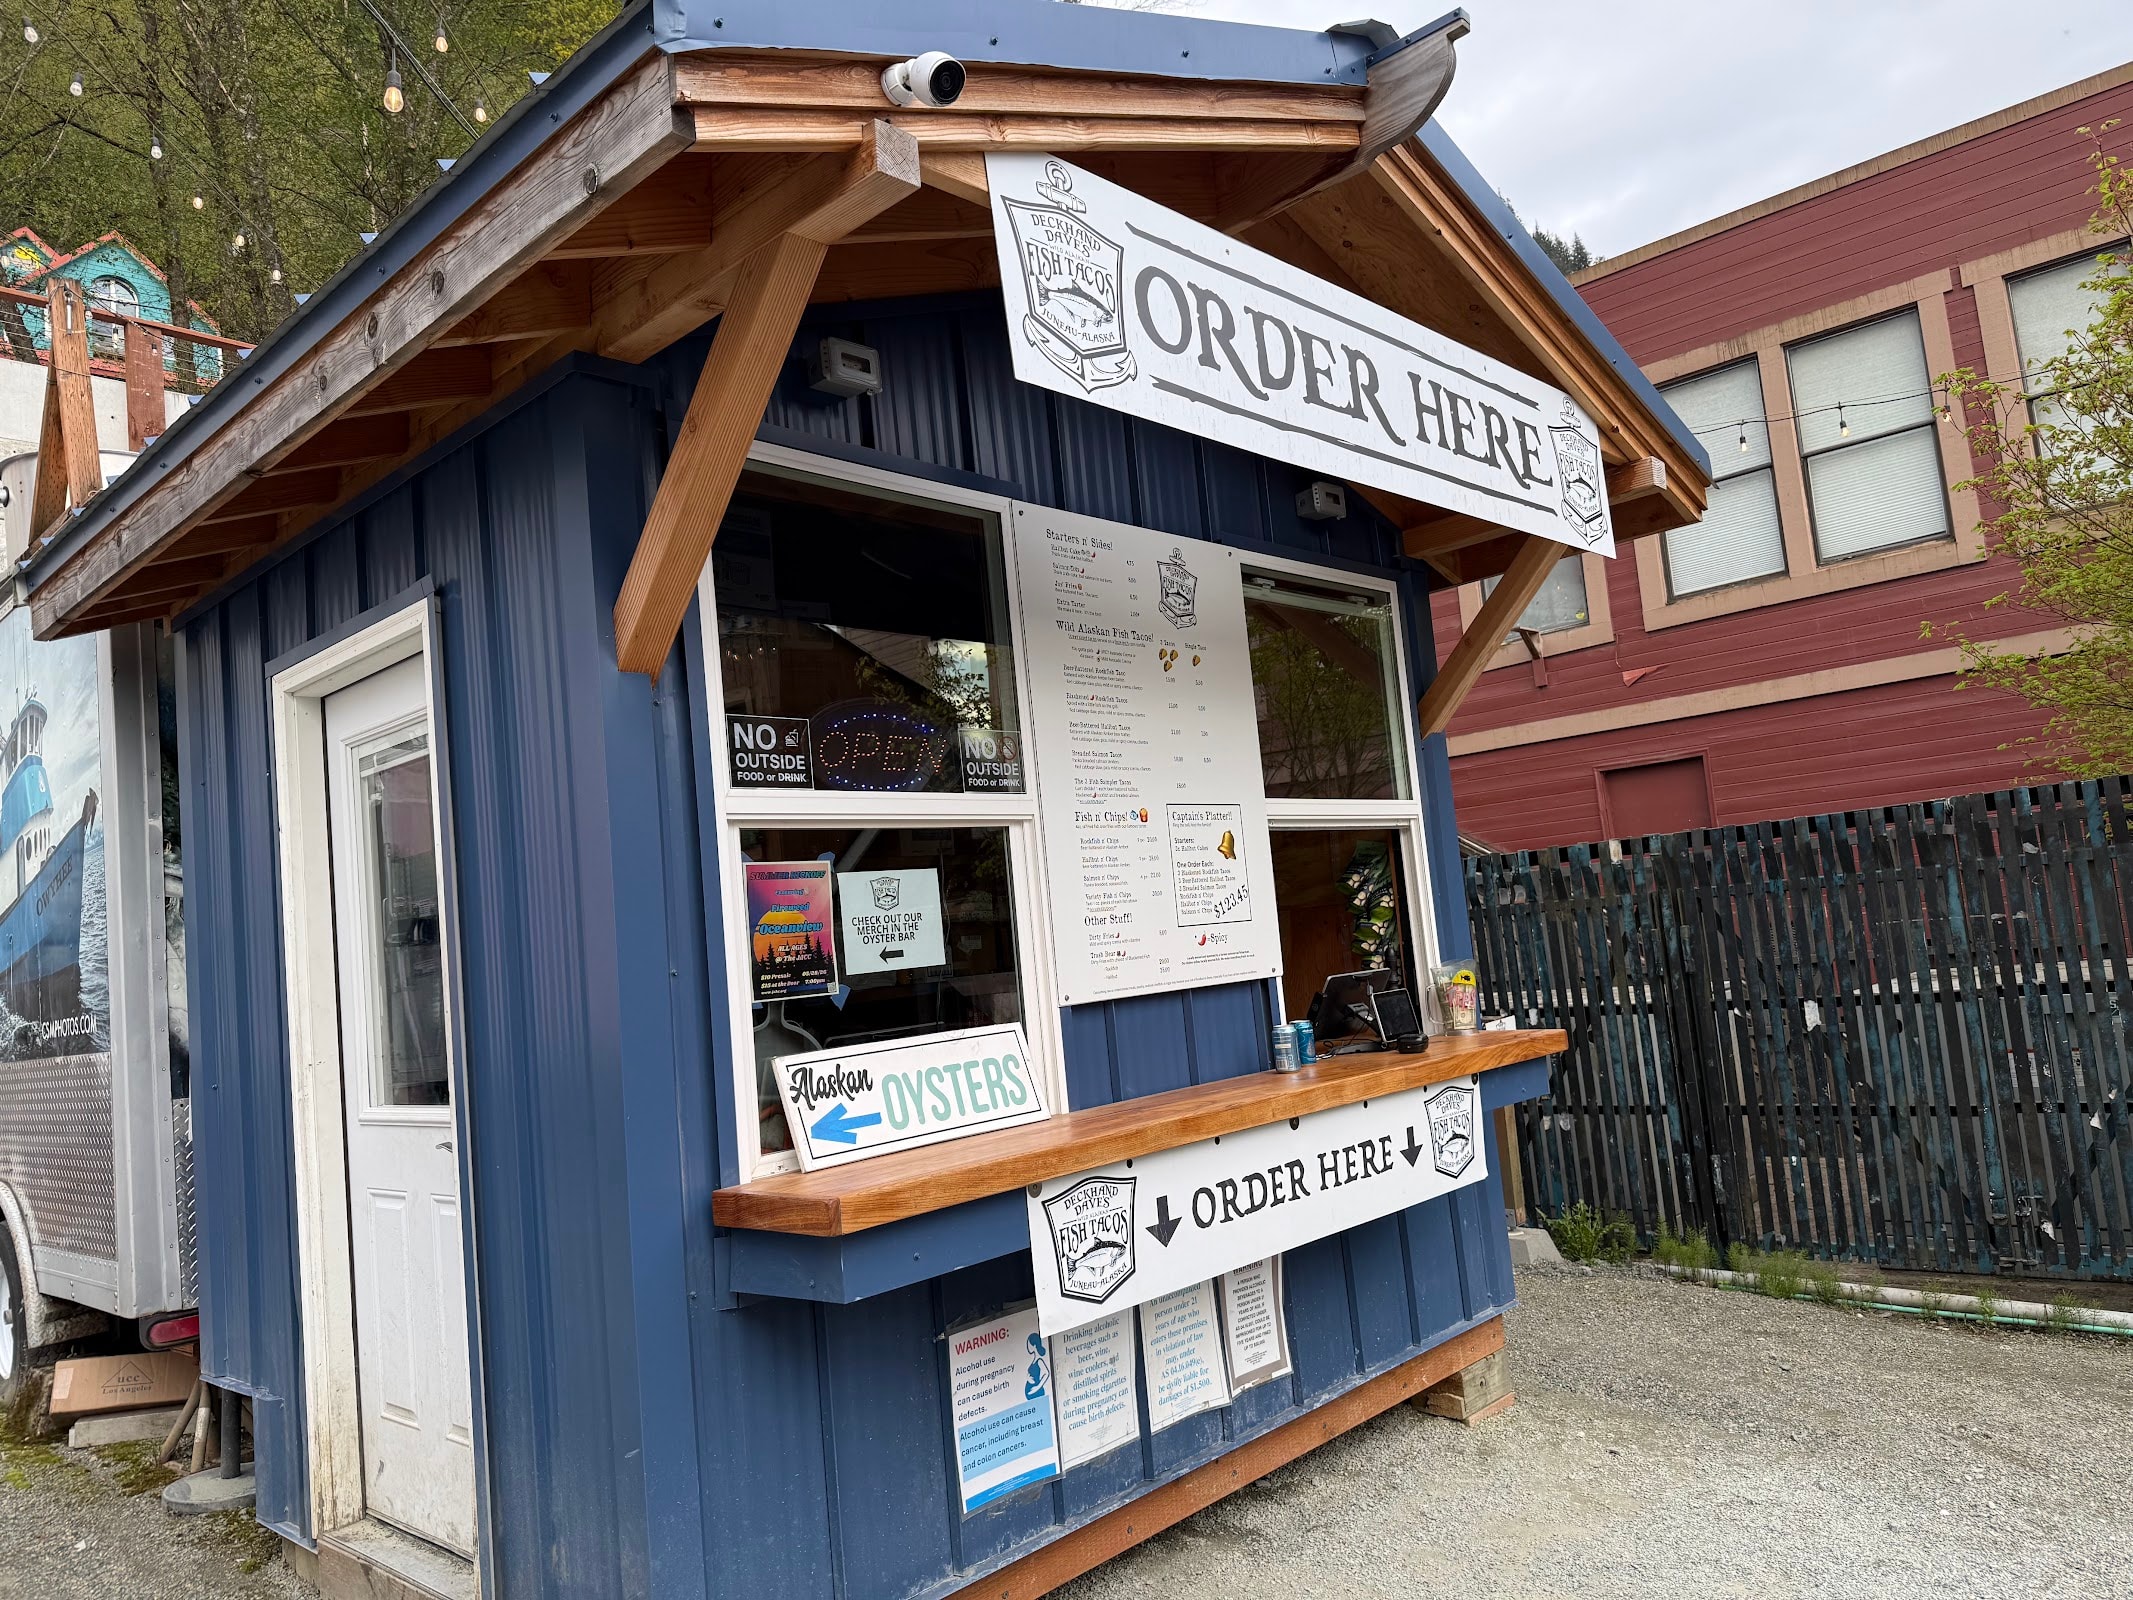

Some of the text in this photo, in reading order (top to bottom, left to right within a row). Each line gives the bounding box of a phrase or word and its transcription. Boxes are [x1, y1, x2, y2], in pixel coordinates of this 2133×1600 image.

[1030, 213, 1101, 252] DECKHAND
[1026, 241, 1115, 314] FISH TACOS
[1041, 308, 1115, 343] JUNEAU-ALASKA
[1134, 266, 1553, 490] ORDER HERE
[1560, 434, 1588, 452] DECKHAND
[1559, 452, 1596, 491] FISH TACOS
[1046, 528, 1079, 545] Starters
[1056, 620, 1074, 632] Wild
[1078, 624, 1110, 637] Alaskan
[1112, 628, 1129, 640] Fish
[1131, 631, 1154, 642] Tacos!
[734, 723, 777, 750] NO
[965, 736, 996, 760] NO
[735, 753, 806, 770] OUTSIDE
[819, 731, 948, 773] OPEN
[737, 772, 765, 781] FOOD
[778, 772, 806, 783] DRINK
[966, 762, 1019, 776] OUTSIDE
[968, 777, 1021, 787] FOOD or DRINK
[1075, 812, 1092, 821] Fish
[1105, 812, 1128, 823] Chips!
[1173, 811, 1203, 822] Captain's
[36, 856, 73, 917] OWYHEE
[1214, 884, 1248, 918] $123.45
[759, 920, 823, 935] Oceanview
[852, 912, 922, 926] CHECK OUT OUR
[857, 922, 919, 935] MERCH IN THE
[1085, 913, 1133, 926] Other Stuff!
[863, 932, 915, 944] OYSTER BAR
[41, 1015, 97, 1040] CSMPHOTOS.COM
[789, 1053, 1027, 1131] Alaskan OYSTERS
[1436, 1092, 1464, 1109] DECKHAND
[1433, 1112, 1470, 1142] FISH TACOS
[1191, 1134, 1395, 1229] ORDER HERE
[1064, 1184, 1118, 1210] DECKHAND
[1059, 1210, 1128, 1258] FISH TACOS
[1070, 1262, 1127, 1291] JUNEAU-ALASKA
[1154, 1296, 1198, 1321] person under 21
[1155, 1310, 1200, 1332] years of age who
[955, 1328, 1009, 1355] WARNING:
[1063, 1318, 1120, 1343] Drinking alcoholic
[1151, 1319, 1208, 1346] enters these premises
[1065, 1339, 1097, 1355] beverages
[1098, 1332, 1111, 1344] such
[1155, 1332, 1204, 1357] in violation of law
[1180, 1347, 1196, 1358] under
[955, 1356, 996, 1376] Alcohol use
[1068, 1353, 1120, 1379] wine coolers, and
[1078, 1349, 1110, 1364] beer, wine,
[956, 1364, 1015, 1391] during pregnancy
[1073, 1368, 1117, 1391] distilled spirits
[1158, 1384, 1165, 1393] be
[1184, 1370, 1199, 1382] liable
[1200, 1366, 1209, 1376] for
[1161, 1370, 1169, 1379] AS
[120, 1386, 152, 1394] Angeles
[957, 1381, 1010, 1406] can cause birth
[1063, 1375, 1127, 1407] or smoking cigarettes
[1159, 1390, 1182, 1406] damages
[1184, 1386, 1189, 1394] of
[958, 1406, 987, 1422] defects.
[1063, 1387, 1129, 1420] during pregnancy can
[1069, 1401, 1126, 1430] cause birth defects.
[960, 1407, 1036, 1441] Alcohol use can cause
[961, 1419, 1044, 1457] cancer, including breast
[963, 1442, 1027, 1472] and colon cancers.
